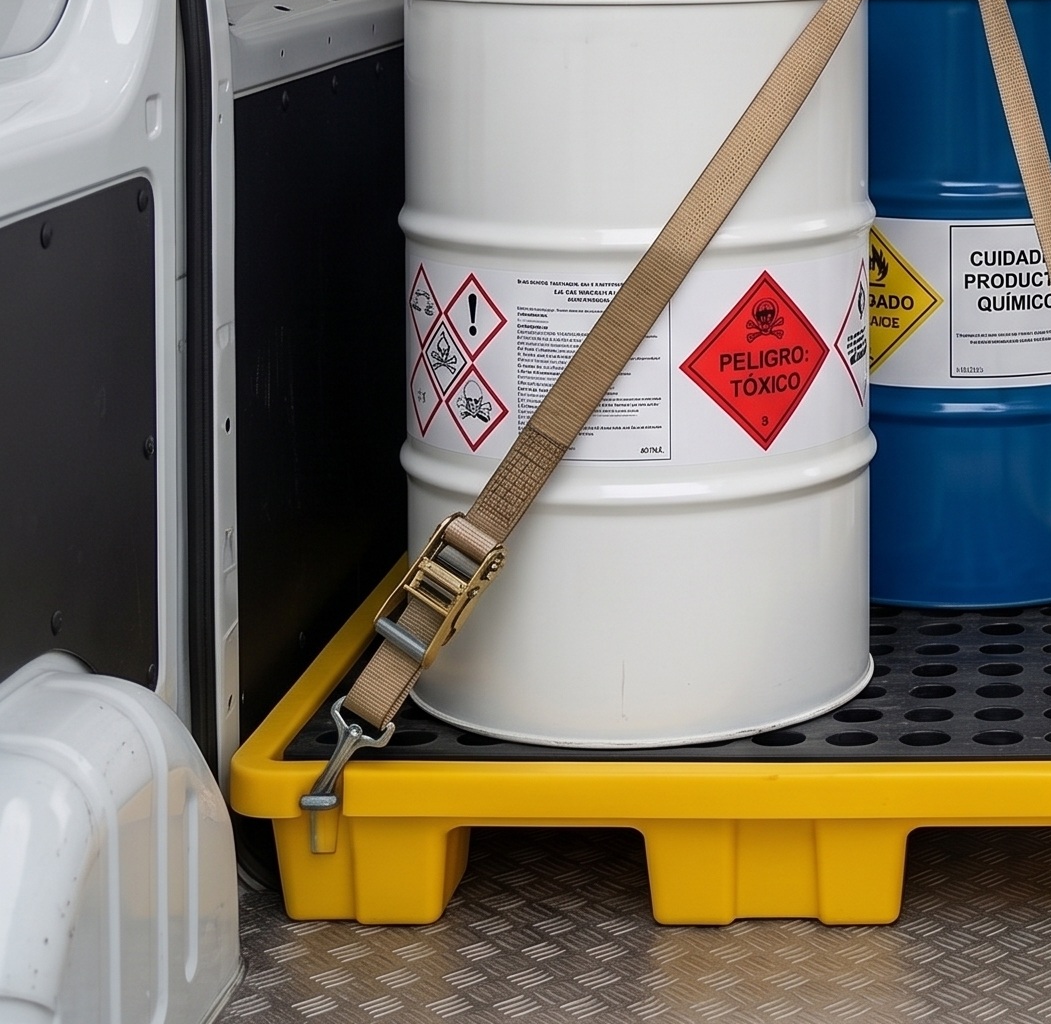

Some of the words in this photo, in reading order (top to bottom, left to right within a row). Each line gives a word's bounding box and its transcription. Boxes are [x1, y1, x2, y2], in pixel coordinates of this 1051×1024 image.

[970, 249, 1046, 267] CUIDAD
[719, 346, 809, 372] PELIGRO:
[730, 371, 801, 397] TÓXICO
